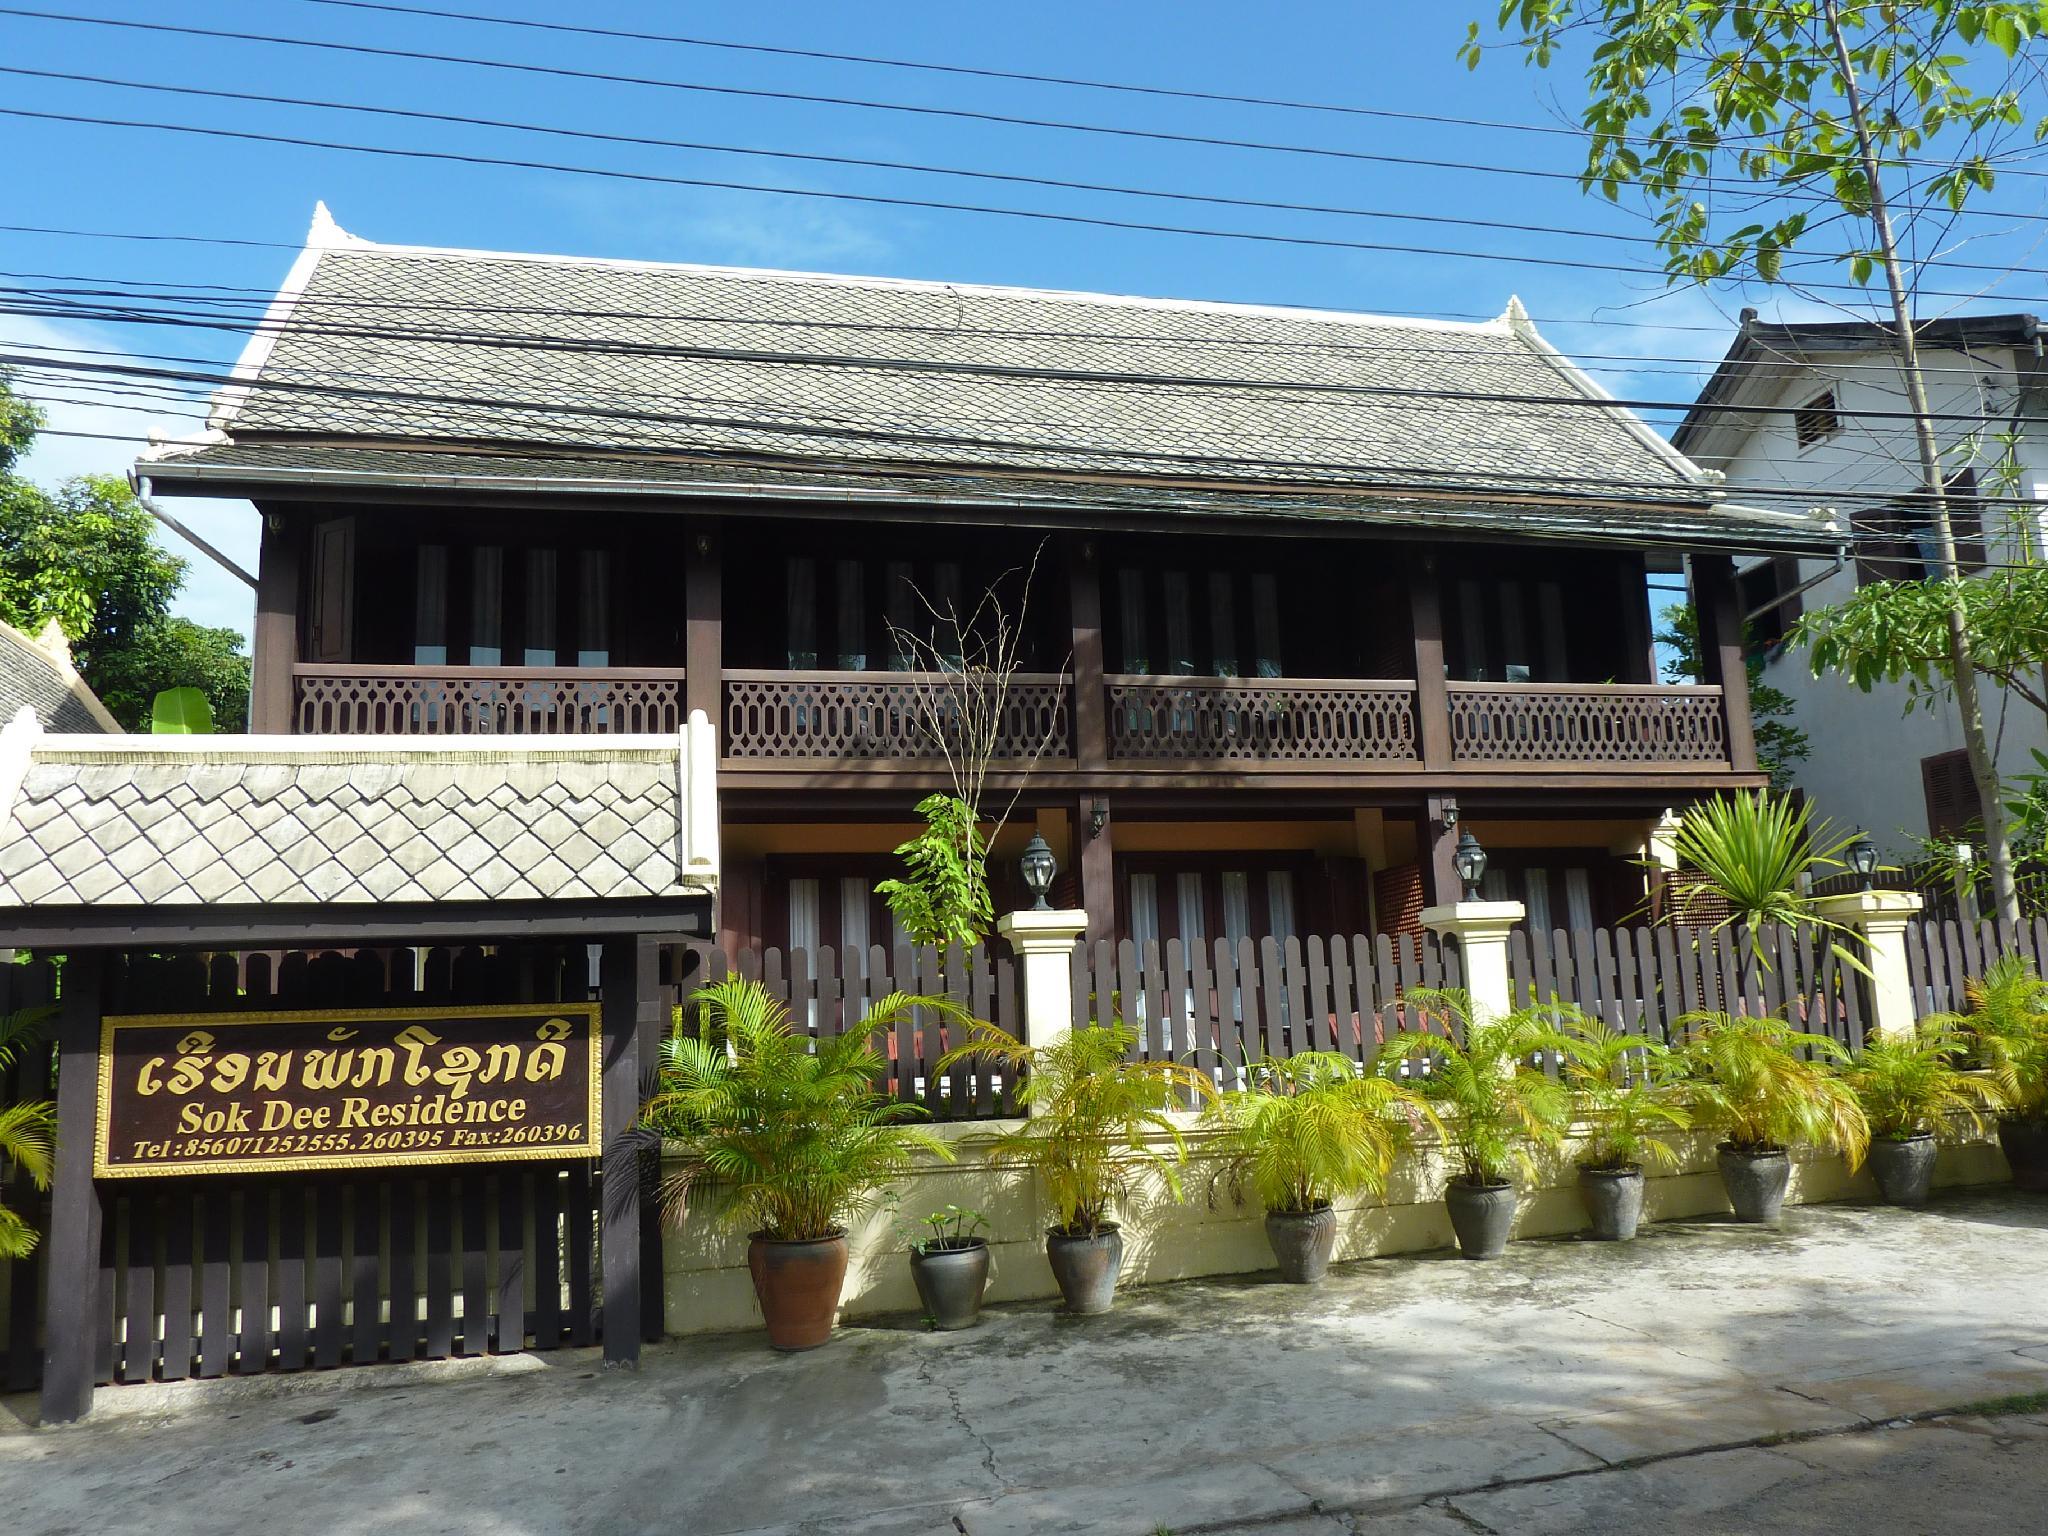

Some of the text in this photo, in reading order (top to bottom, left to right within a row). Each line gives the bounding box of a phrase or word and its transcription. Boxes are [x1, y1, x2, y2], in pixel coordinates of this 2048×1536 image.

[176, 1095, 527, 1134] Sok Dee Residence
